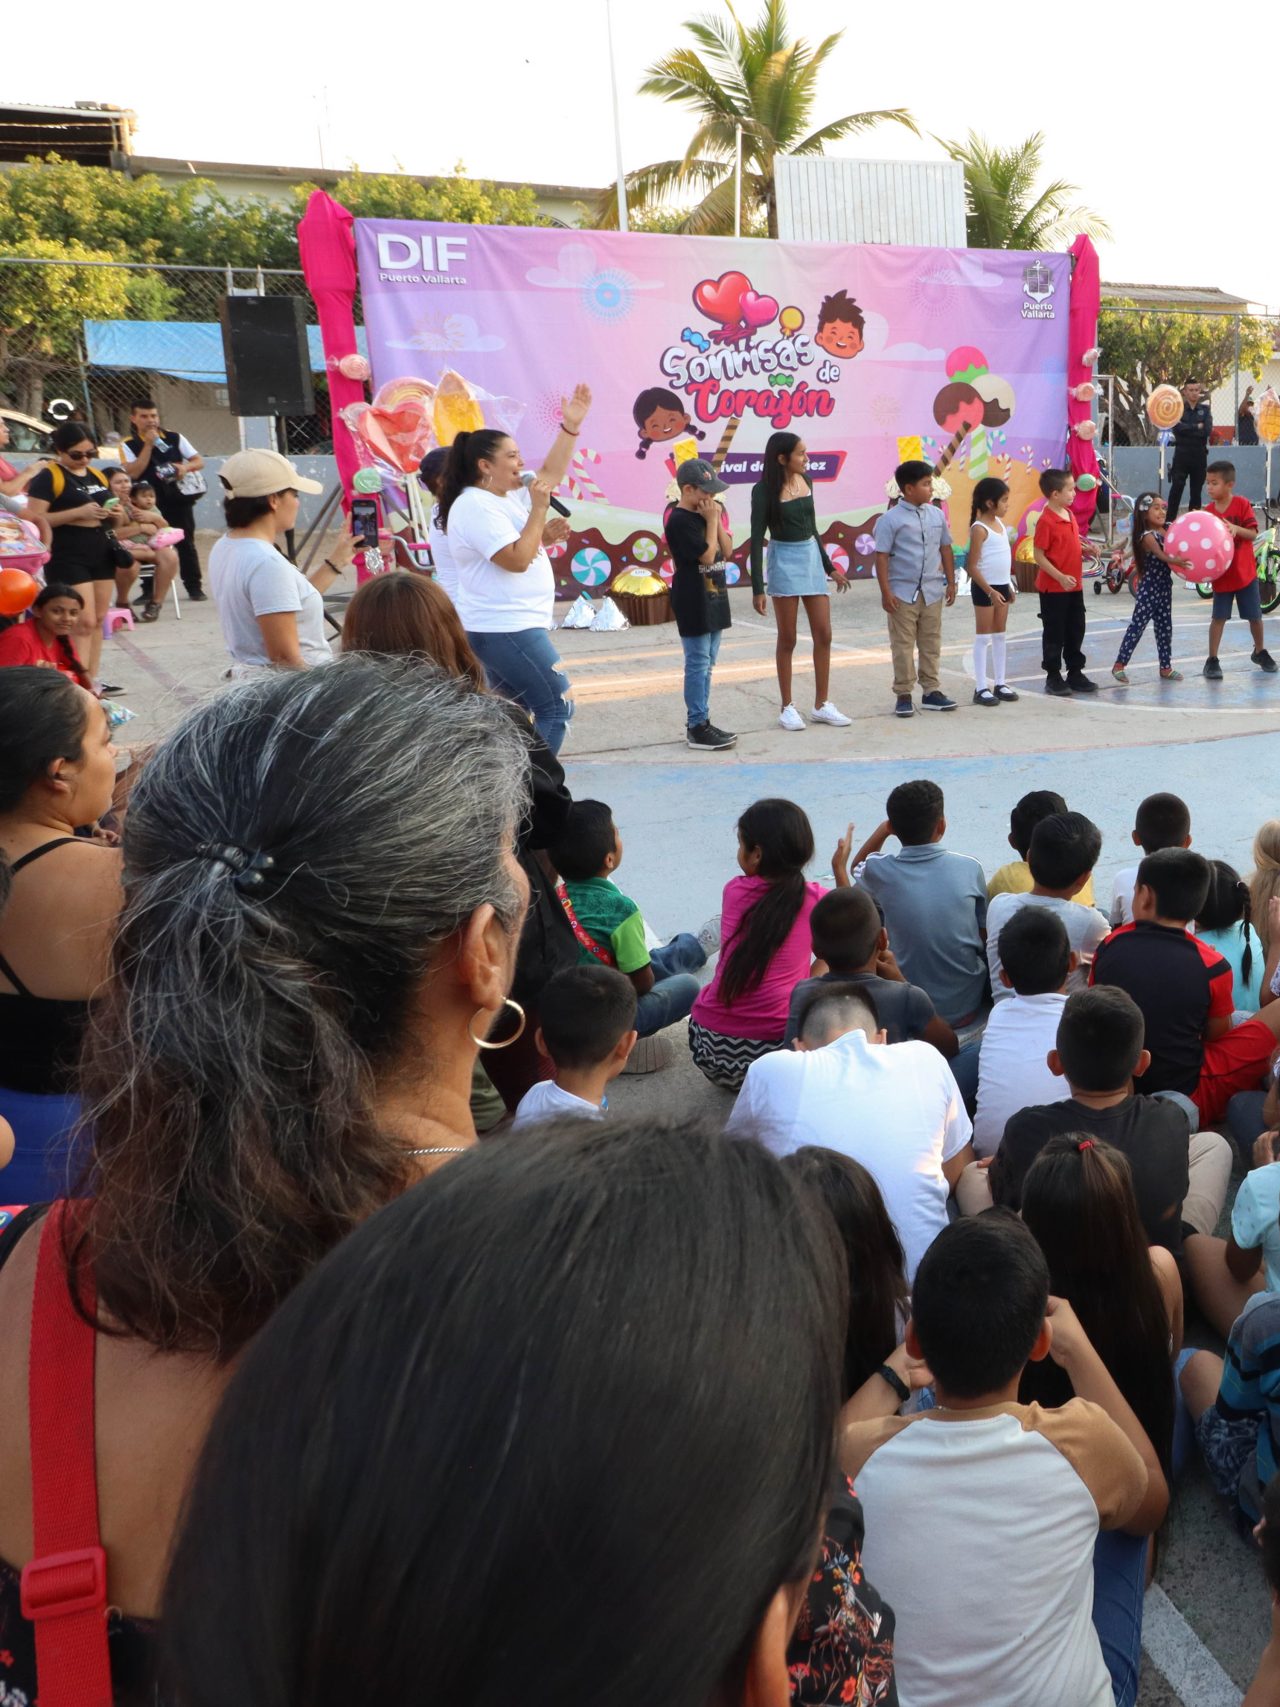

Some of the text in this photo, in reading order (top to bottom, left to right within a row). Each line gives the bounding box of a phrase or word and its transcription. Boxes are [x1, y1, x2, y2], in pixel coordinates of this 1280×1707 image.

[377, 233, 468, 272] DIF
[379, 273, 467, 285] Puerto Vallarta
[1023, 302, 1053, 310] Puerto
[1021, 310, 1055, 319] Vallarta
[660, 334, 841, 388] Sonrisas de
[685, 379, 836, 430] Corazón
[720, 461, 747, 473] ival
